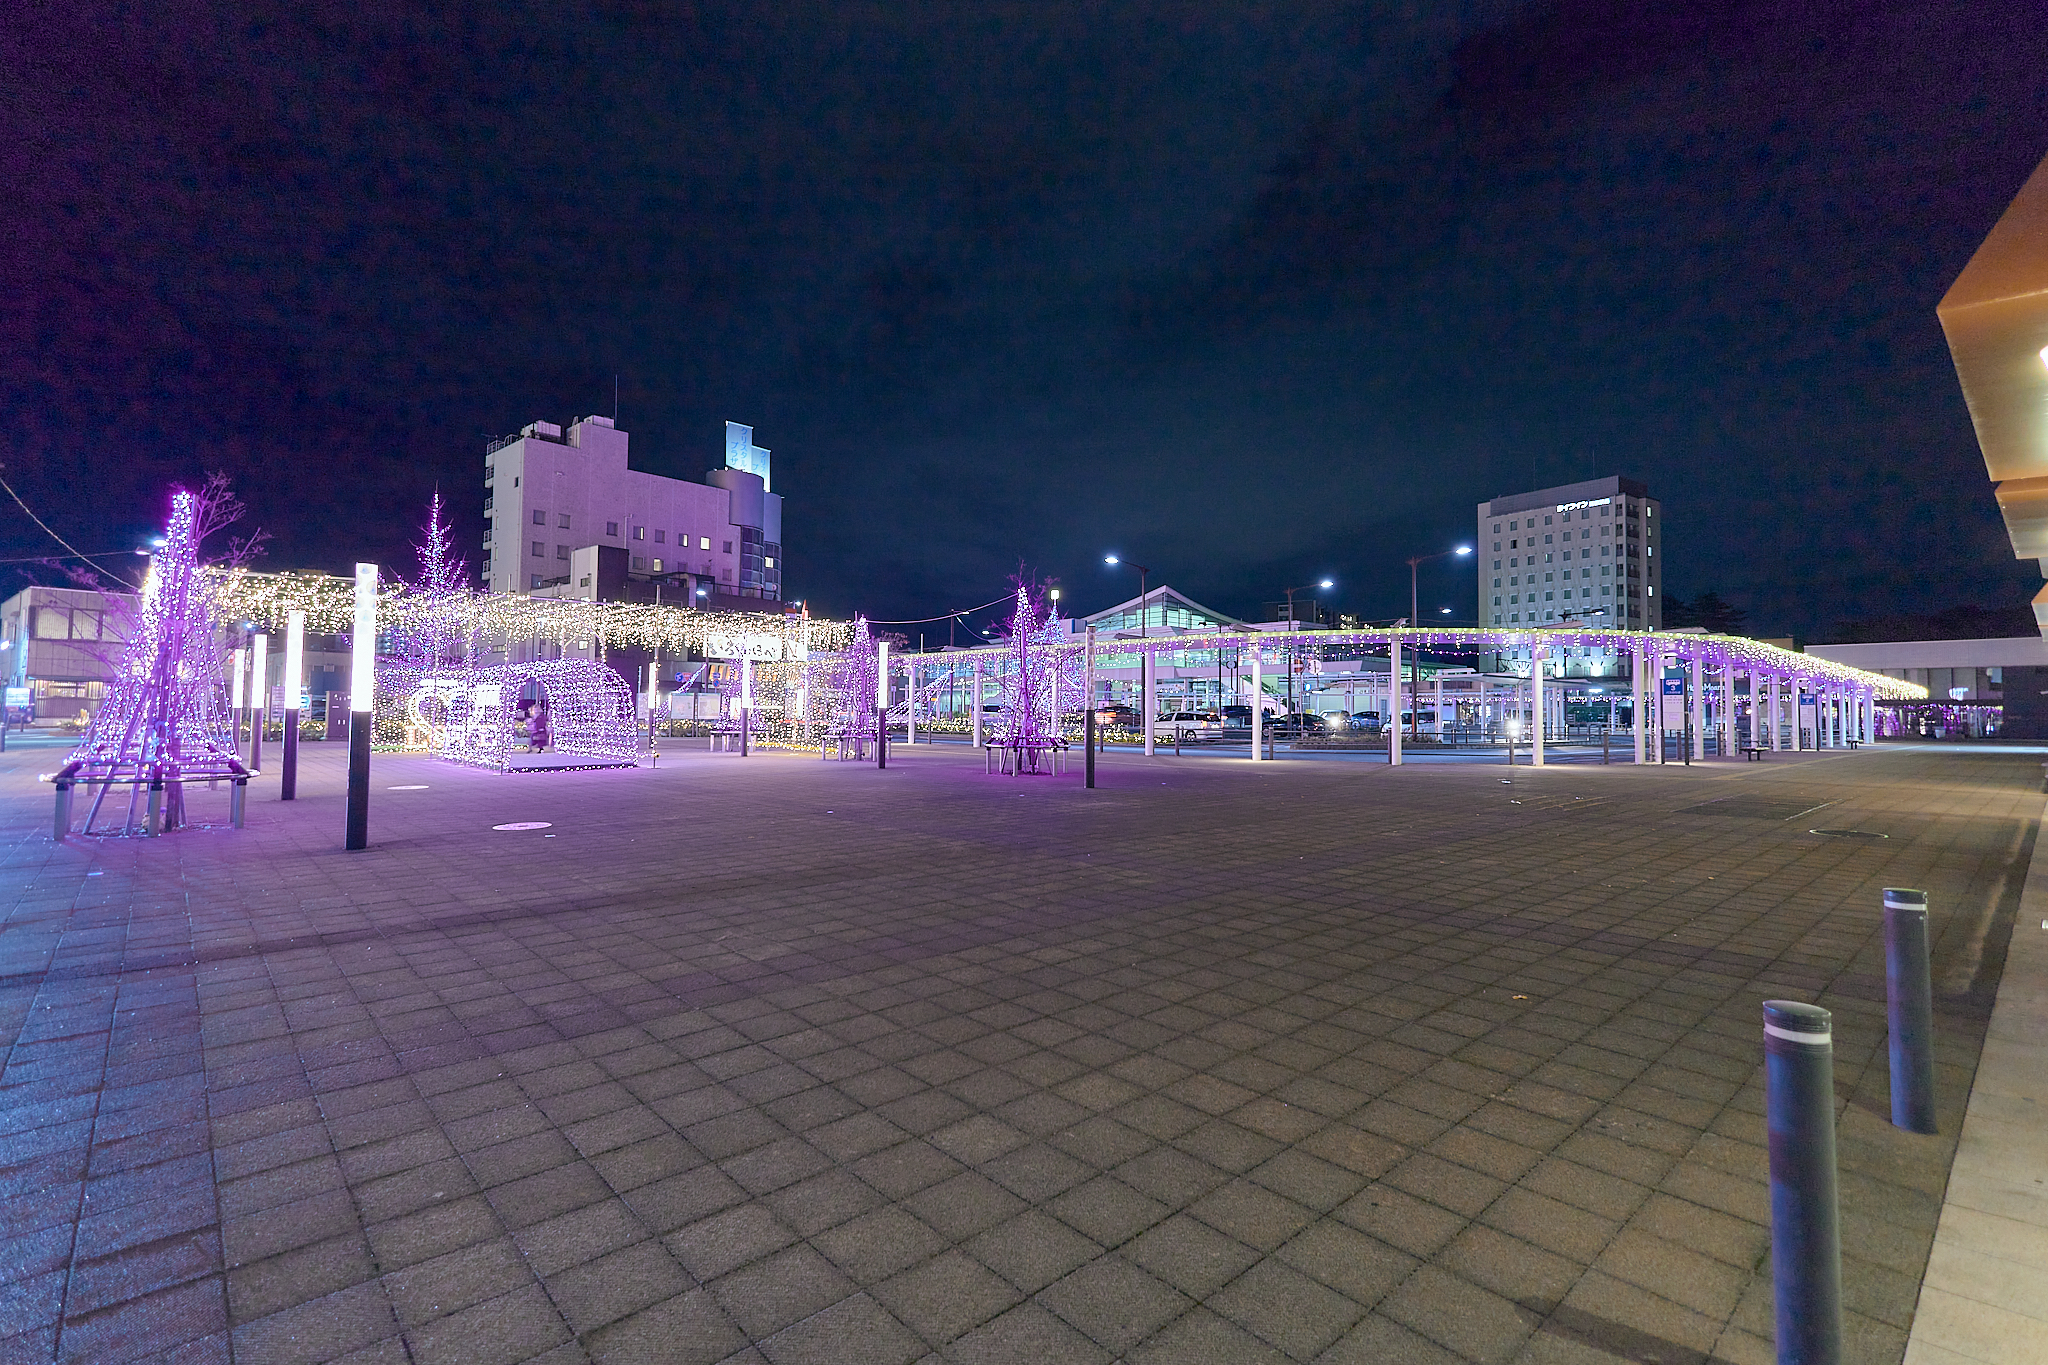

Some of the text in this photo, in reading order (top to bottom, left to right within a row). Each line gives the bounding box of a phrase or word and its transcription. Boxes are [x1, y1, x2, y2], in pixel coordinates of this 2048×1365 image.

[730, 442, 738, 466] プラザ
[740, 427, 748, 467] クリスタル
